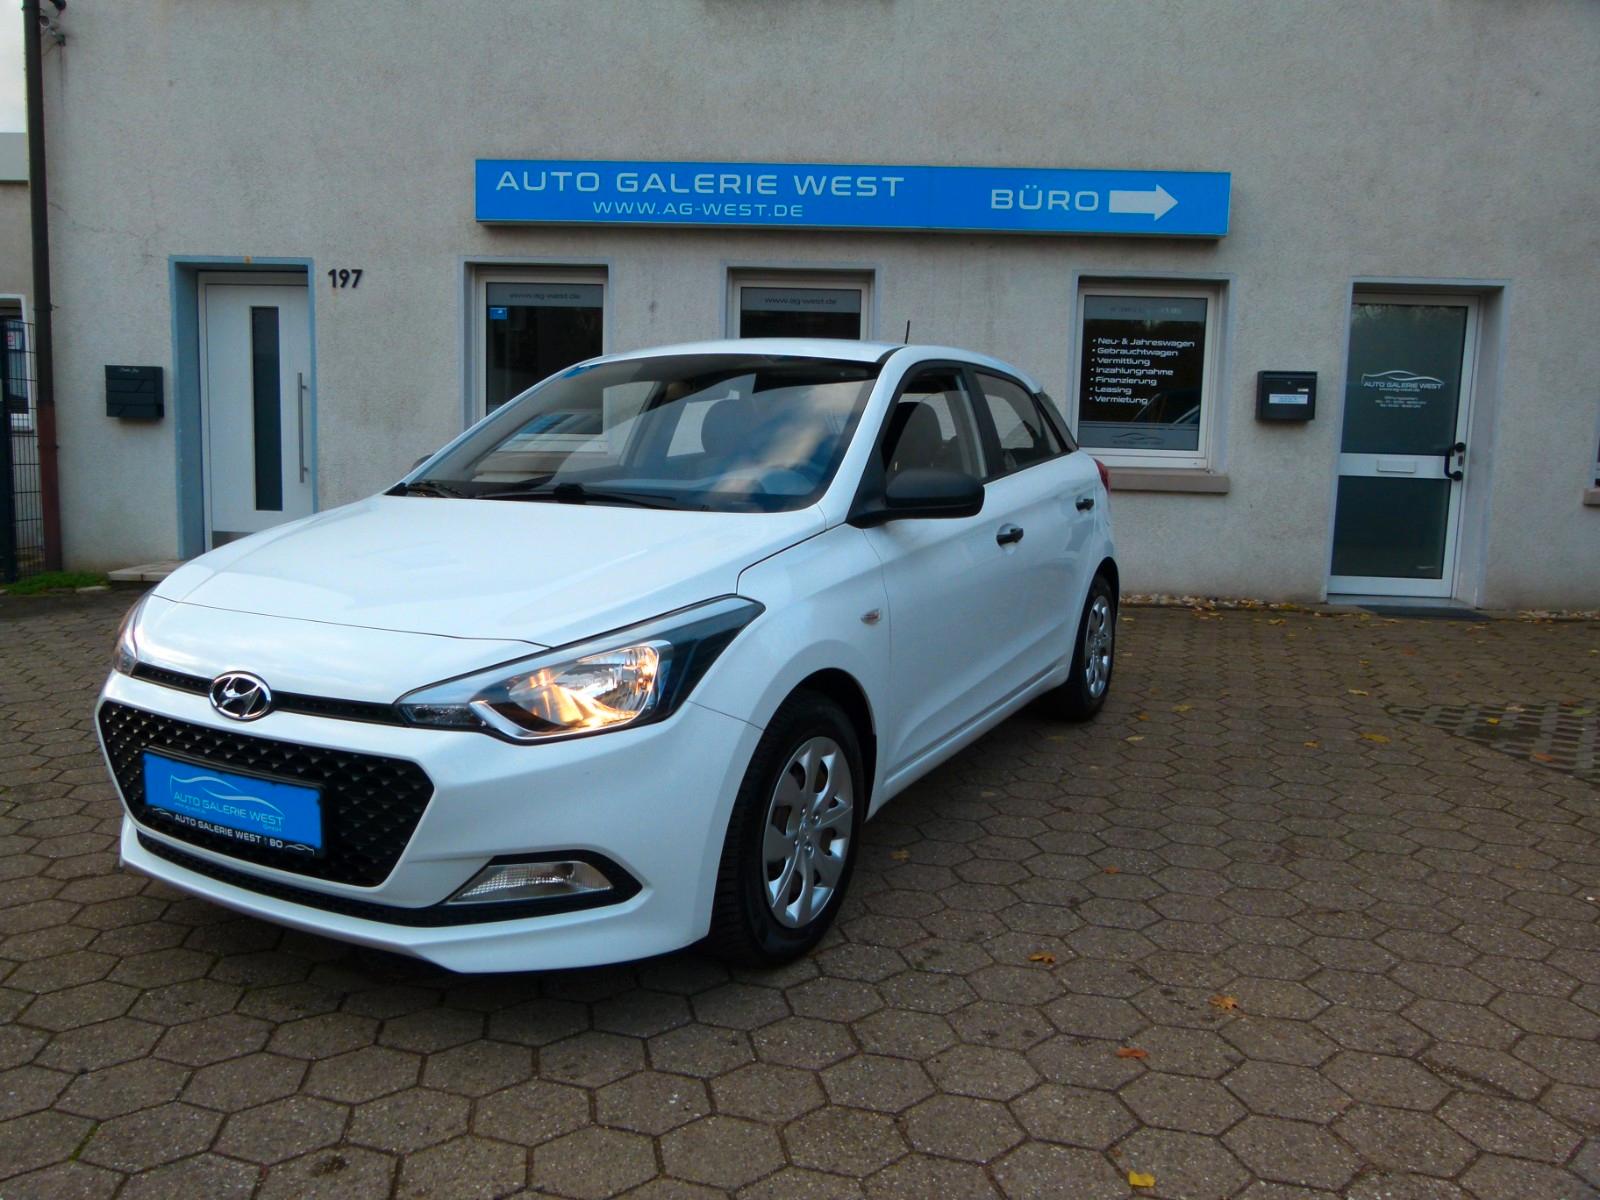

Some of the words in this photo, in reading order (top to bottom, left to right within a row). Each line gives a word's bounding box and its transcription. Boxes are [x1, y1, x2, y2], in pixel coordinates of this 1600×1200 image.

[496, 171, 600, 191] AUTO
[616, 173, 777, 195] GALERIE
[794, 175, 905, 197] WEST
[990, 184, 1099, 212] BÜRO
[593, 201, 804, 217] WWW.AG-WEST.DE
[327, 269, 363, 288] 197
[1130, 338, 1195, 347] Jahreswagen
[1097, 347, 1178, 357] Gebrauchtwagen
[1097, 357, 1151, 366] Vermittlung
[1096, 367, 1174, 376] Inzahlungnahme
[1095, 376, 1157, 386] Finanzierung
[1095, 386, 1132, 395] Leasing
[1094, 396, 1148, 405] Vermietung
[174, 791, 200, 806] AUTO
[202, 799, 247, 818] GALERIE
[249, 810, 283, 825] WEST
[174, 814, 196, 826] AUTO
[198, 820, 233, 837] GALERIE
[235, 830, 262, 844] WEST
